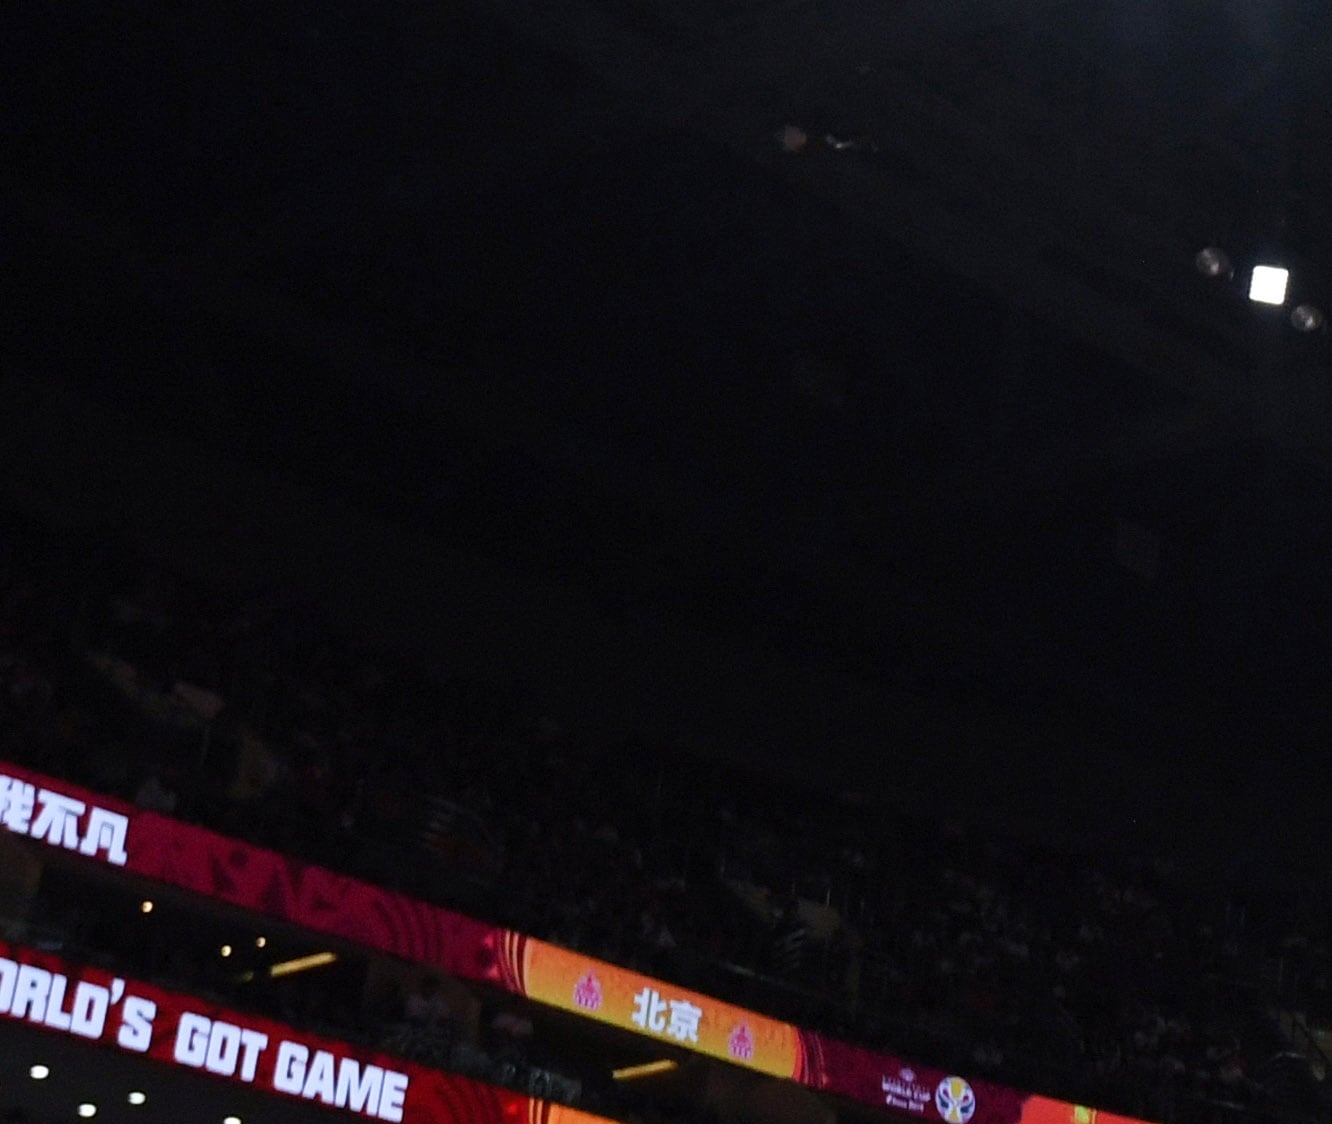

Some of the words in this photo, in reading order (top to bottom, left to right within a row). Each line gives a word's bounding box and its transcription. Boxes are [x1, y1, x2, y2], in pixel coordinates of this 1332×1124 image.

[631, 986, 703, 1044] 北京
[173, 1011, 269, 1083] GOT
[273, 1040, 410, 1124] GAME
